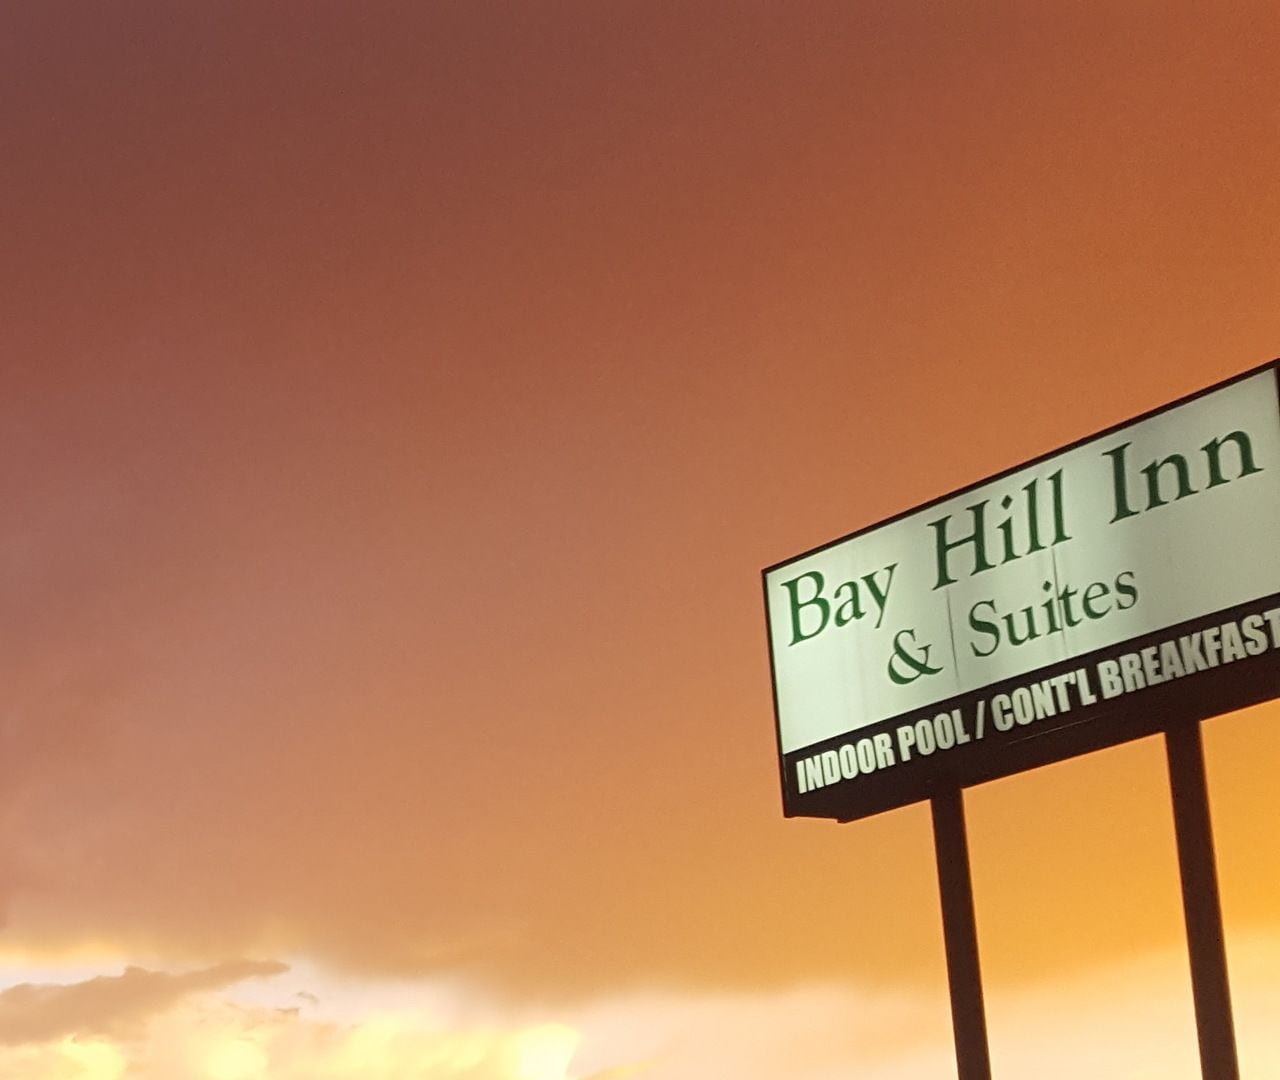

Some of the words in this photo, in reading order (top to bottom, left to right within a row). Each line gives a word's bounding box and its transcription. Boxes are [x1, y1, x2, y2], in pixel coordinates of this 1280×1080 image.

[781, 562, 899, 648] Bay
[927, 468, 1073, 591] Hill
[1102, 427, 1264, 525] Inn
[887, 628, 944, 686] &
[968, 570, 1139, 658] Suites
[796, 732, 896, 794] INDOOR
[896, 708, 971, 762] POOL
[975, 700, 986, 740] /
[991, 666, 1097, 732] CONT'L
[1097, 607, 1280, 700] BREAKFAST
